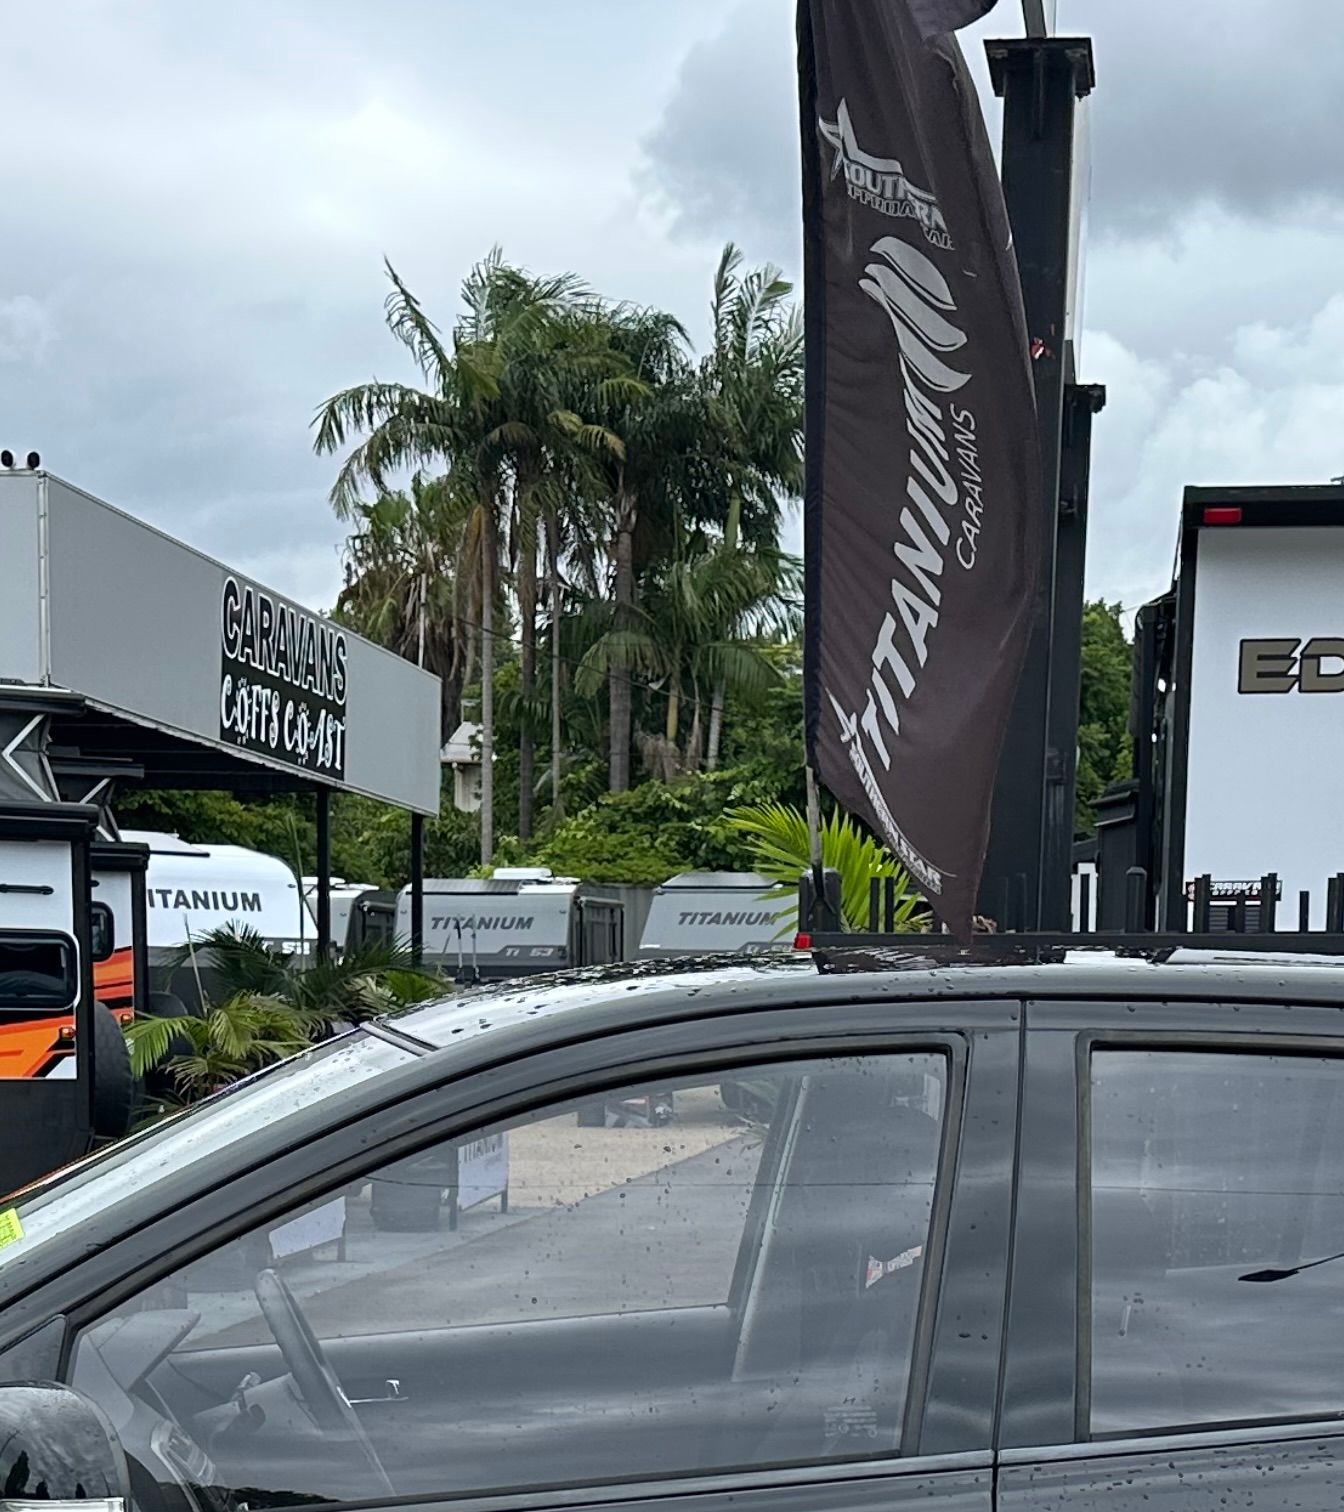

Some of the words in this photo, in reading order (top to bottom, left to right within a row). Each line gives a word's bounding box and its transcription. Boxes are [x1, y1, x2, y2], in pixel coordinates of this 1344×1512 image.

[950, 403, 984, 569] CARAVANS
[861, 386, 958, 771] TITANIUM
[221, 576, 348, 705] CARAVANS
[220, 674, 281, 749] COFFS
[284, 700, 346, 770] COAST
[147, 888, 262, 912] ITANIUM
[431, 916, 534, 930] TITANIUM
[678, 911, 778, 926] TITANIUM
